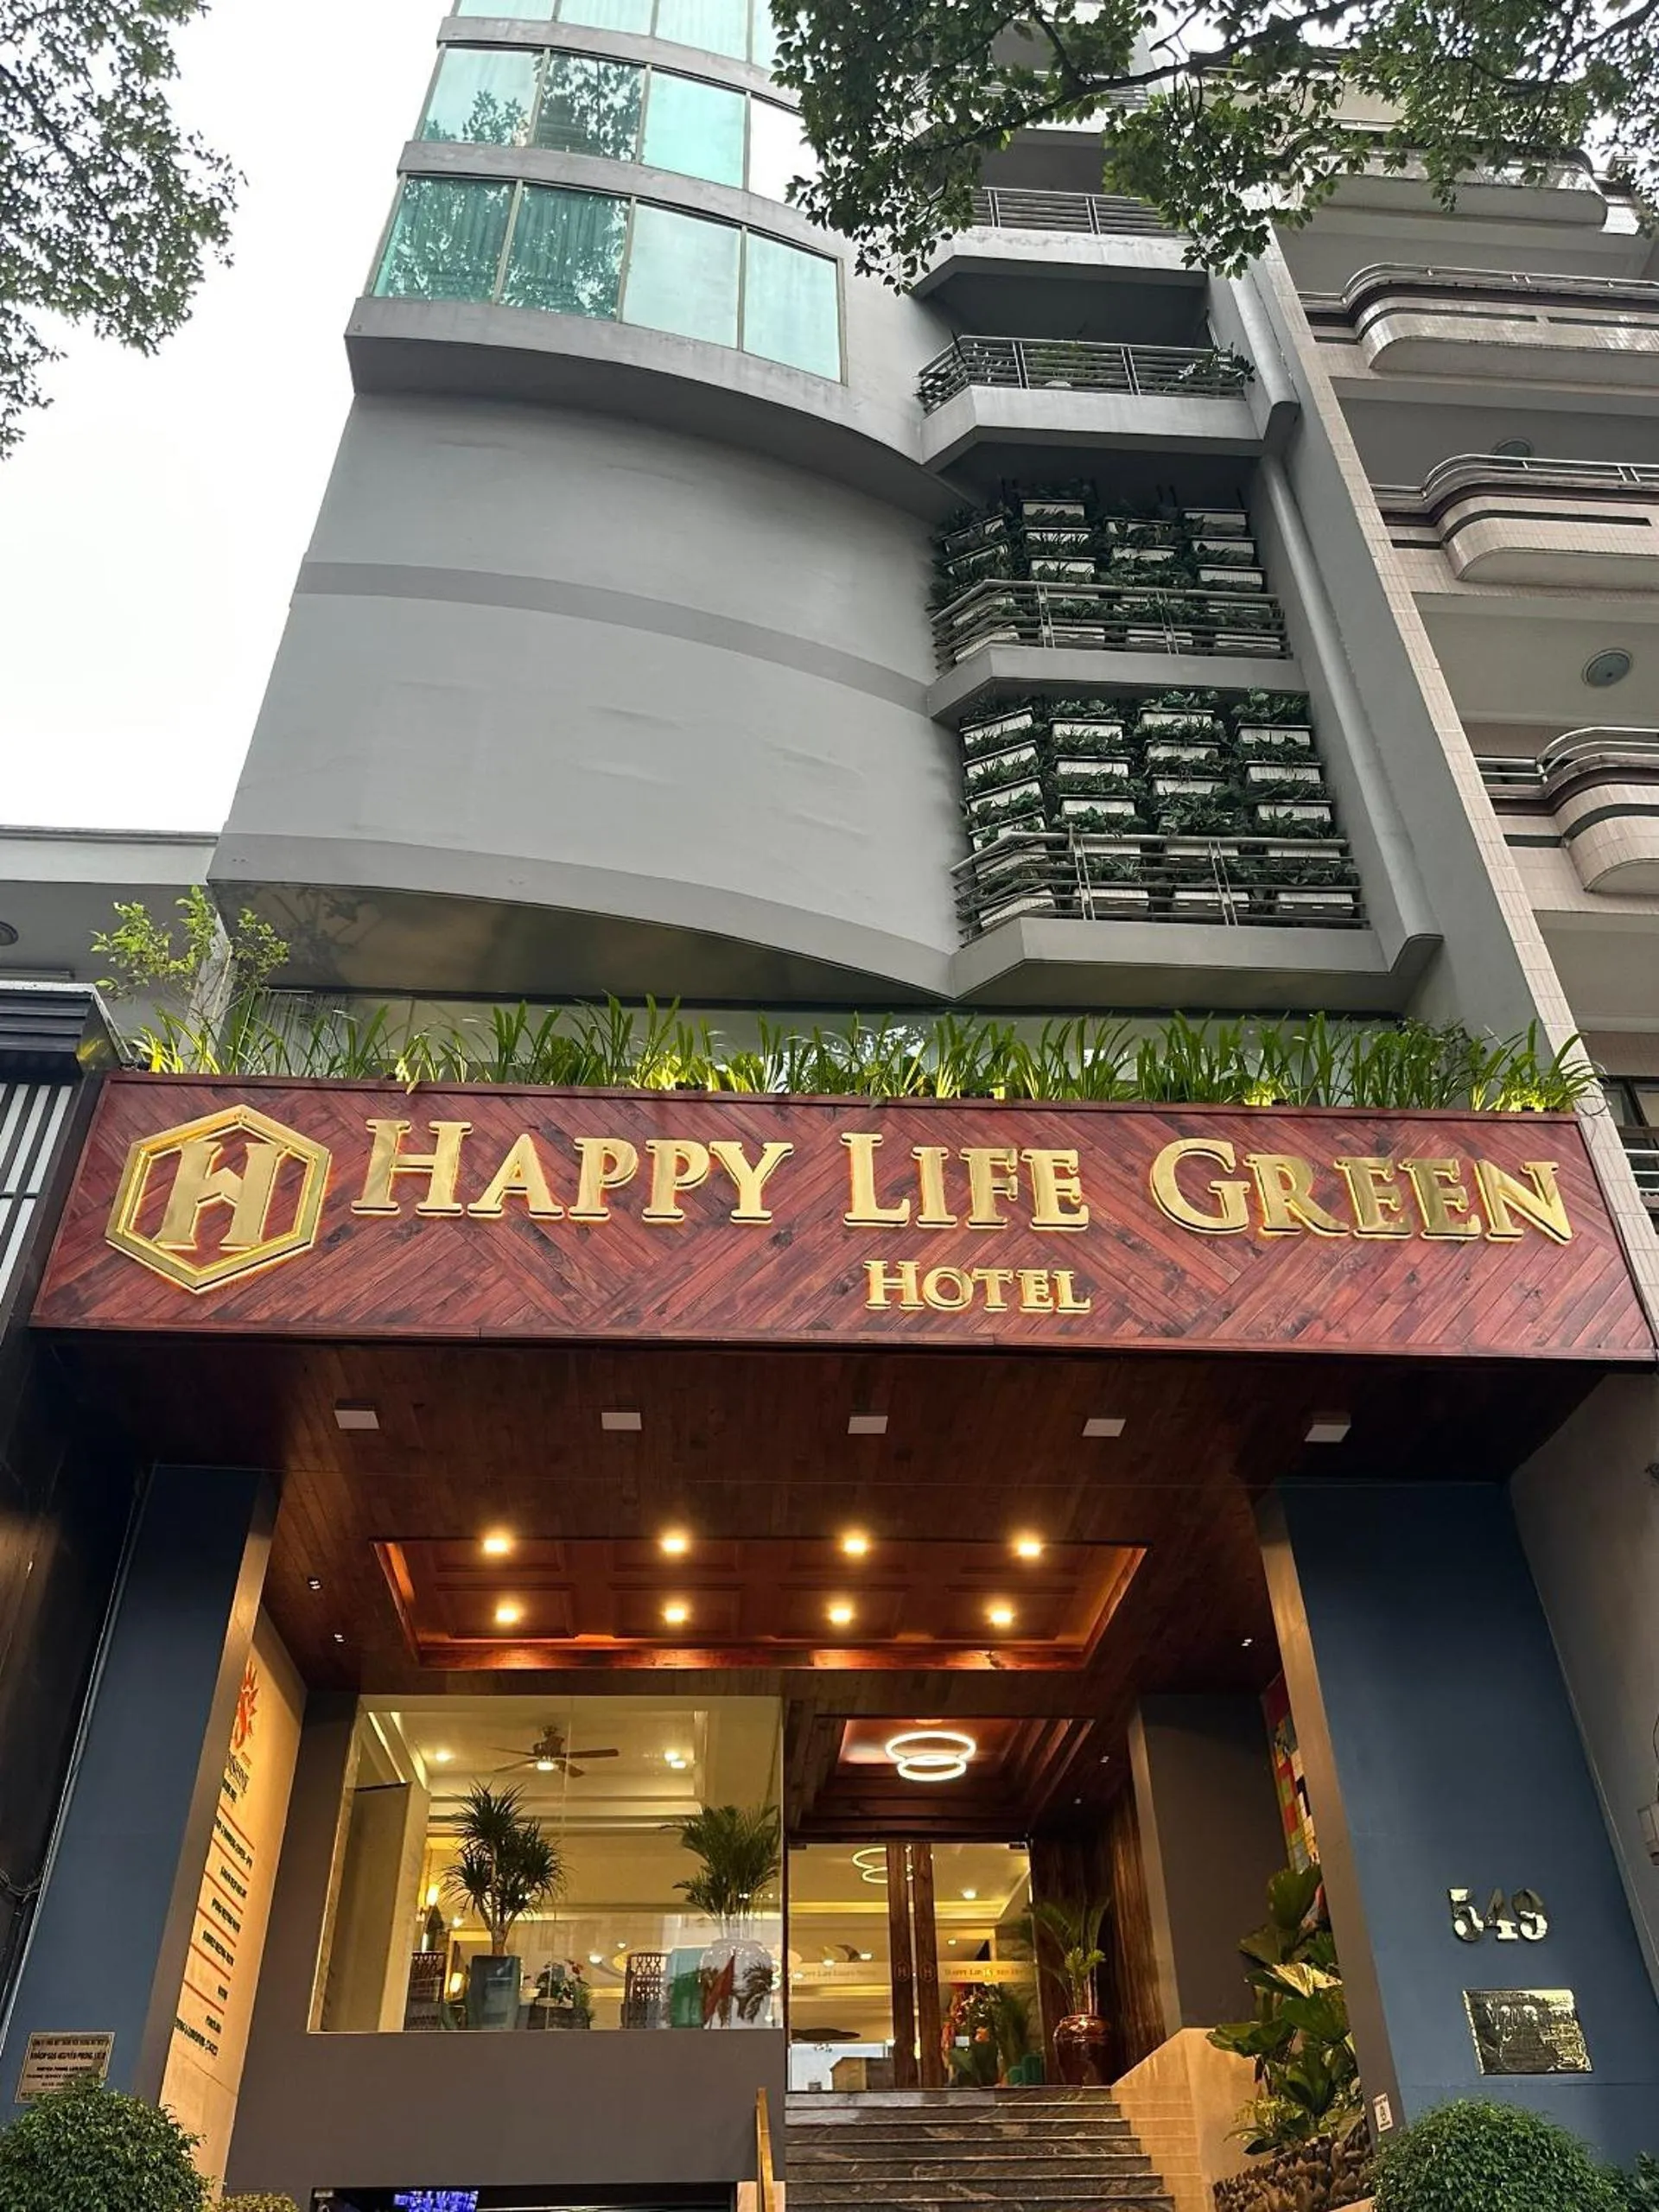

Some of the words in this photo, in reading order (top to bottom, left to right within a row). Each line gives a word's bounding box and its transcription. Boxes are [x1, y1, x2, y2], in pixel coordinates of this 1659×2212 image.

[350, 1118, 794, 1224] HAPPY
[840, 1132, 1090, 1231] LIFE
[1151, 1137, 1573, 1245] GREEN
[862, 1260, 1091, 1313] HOTEL
